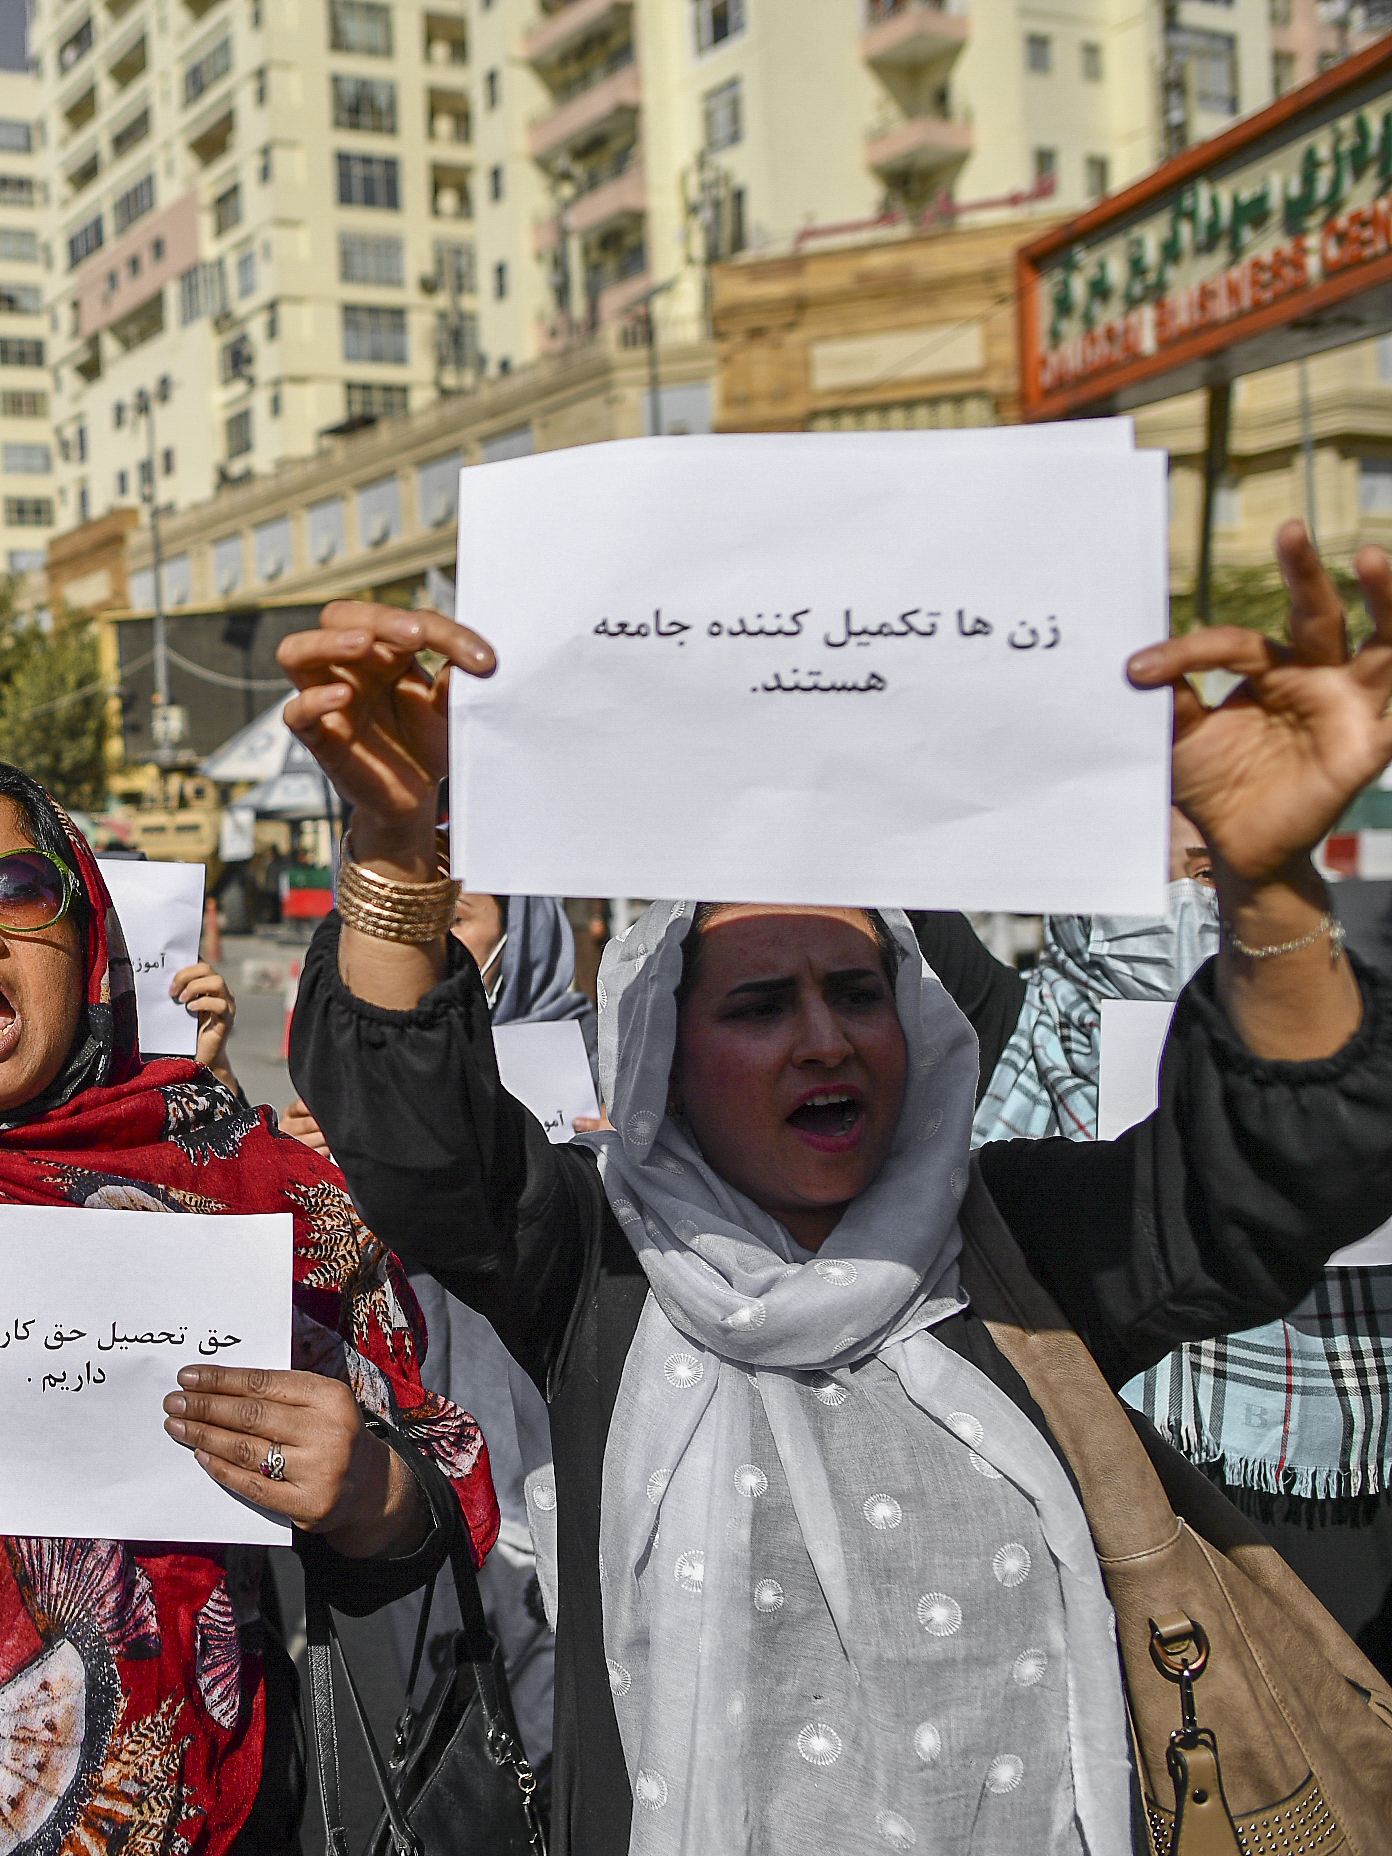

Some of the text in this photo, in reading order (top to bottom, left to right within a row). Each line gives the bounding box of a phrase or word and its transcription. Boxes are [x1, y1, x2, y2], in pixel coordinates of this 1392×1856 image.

[592, 607, 1062, 652] زن ها تکمیل کننده جامعه
[750, 667, 888, 695] هستند.
[44, 1323, 88, 1351] حق
[97, 1321, 189, 1351] تحصیل
[198, 1328, 243, 1356] حق
[42, 1360, 107, 1394] داریم
